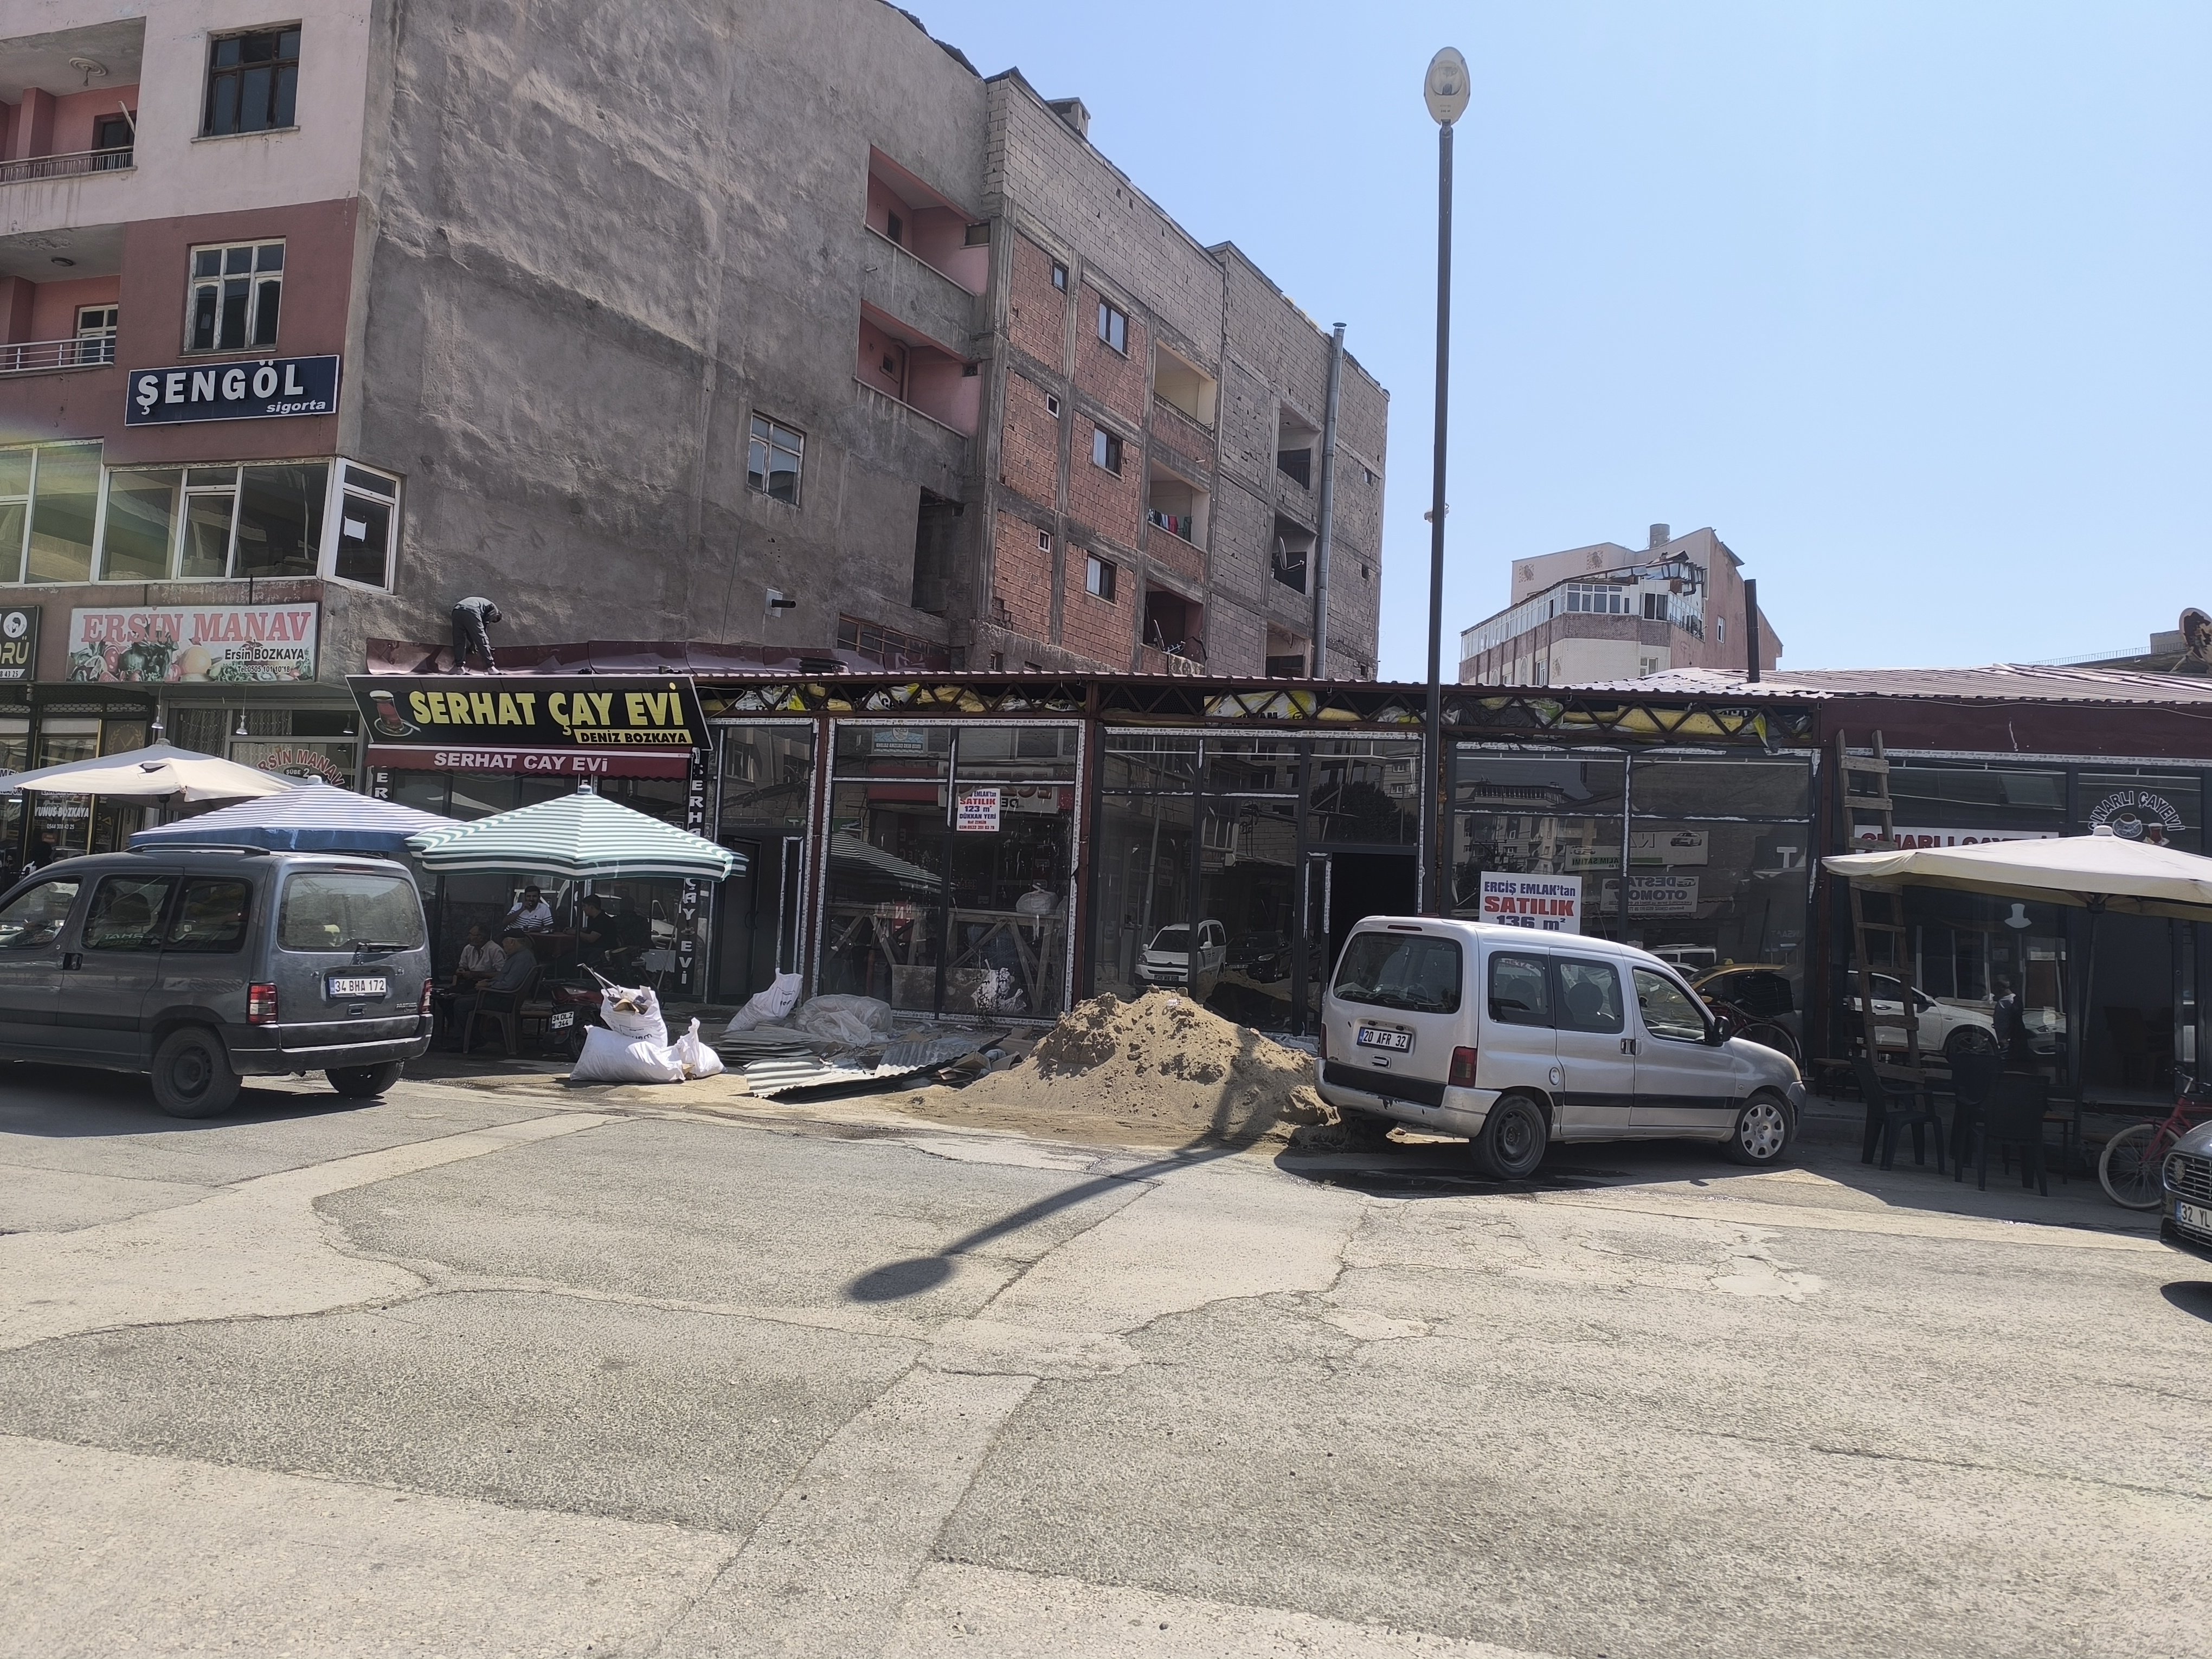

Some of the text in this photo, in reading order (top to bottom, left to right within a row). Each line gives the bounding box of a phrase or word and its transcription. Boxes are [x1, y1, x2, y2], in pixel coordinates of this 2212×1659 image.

[136, 360, 304, 415] ŞENGÖL
[266, 400, 325, 414] sigorta
[191, 612, 311, 642] MANAV
[0, 635, 29, 664] RÜ
[224, 648, 304, 660] Ersin BOZKAYA
[409, 682, 684, 736] SERHAT ÇAY EVİ
[580, 730, 687, 743] DENİZ BOZKAYA
[296, 749, 345, 786] MANAV
[434, 752, 517, 769] SERHAT
[303, 768, 310, 777] 2
[35, 807, 57, 818] YUNUS
[1484, 880, 1576, 897] ERCİŞ EMLAK'tan
[1484, 896, 1574, 917] SATILIK
[1496, 915, 1535, 929] 136
[335, 979, 385, 992] 34 BHA 172
[557, 1019, 569, 1027] 344
[560, 1012, 573, 1020] DLZ
[1363, 1031, 1406, 1048] 20 AFR 32
[2182, 1205, 2193, 1223] 32
